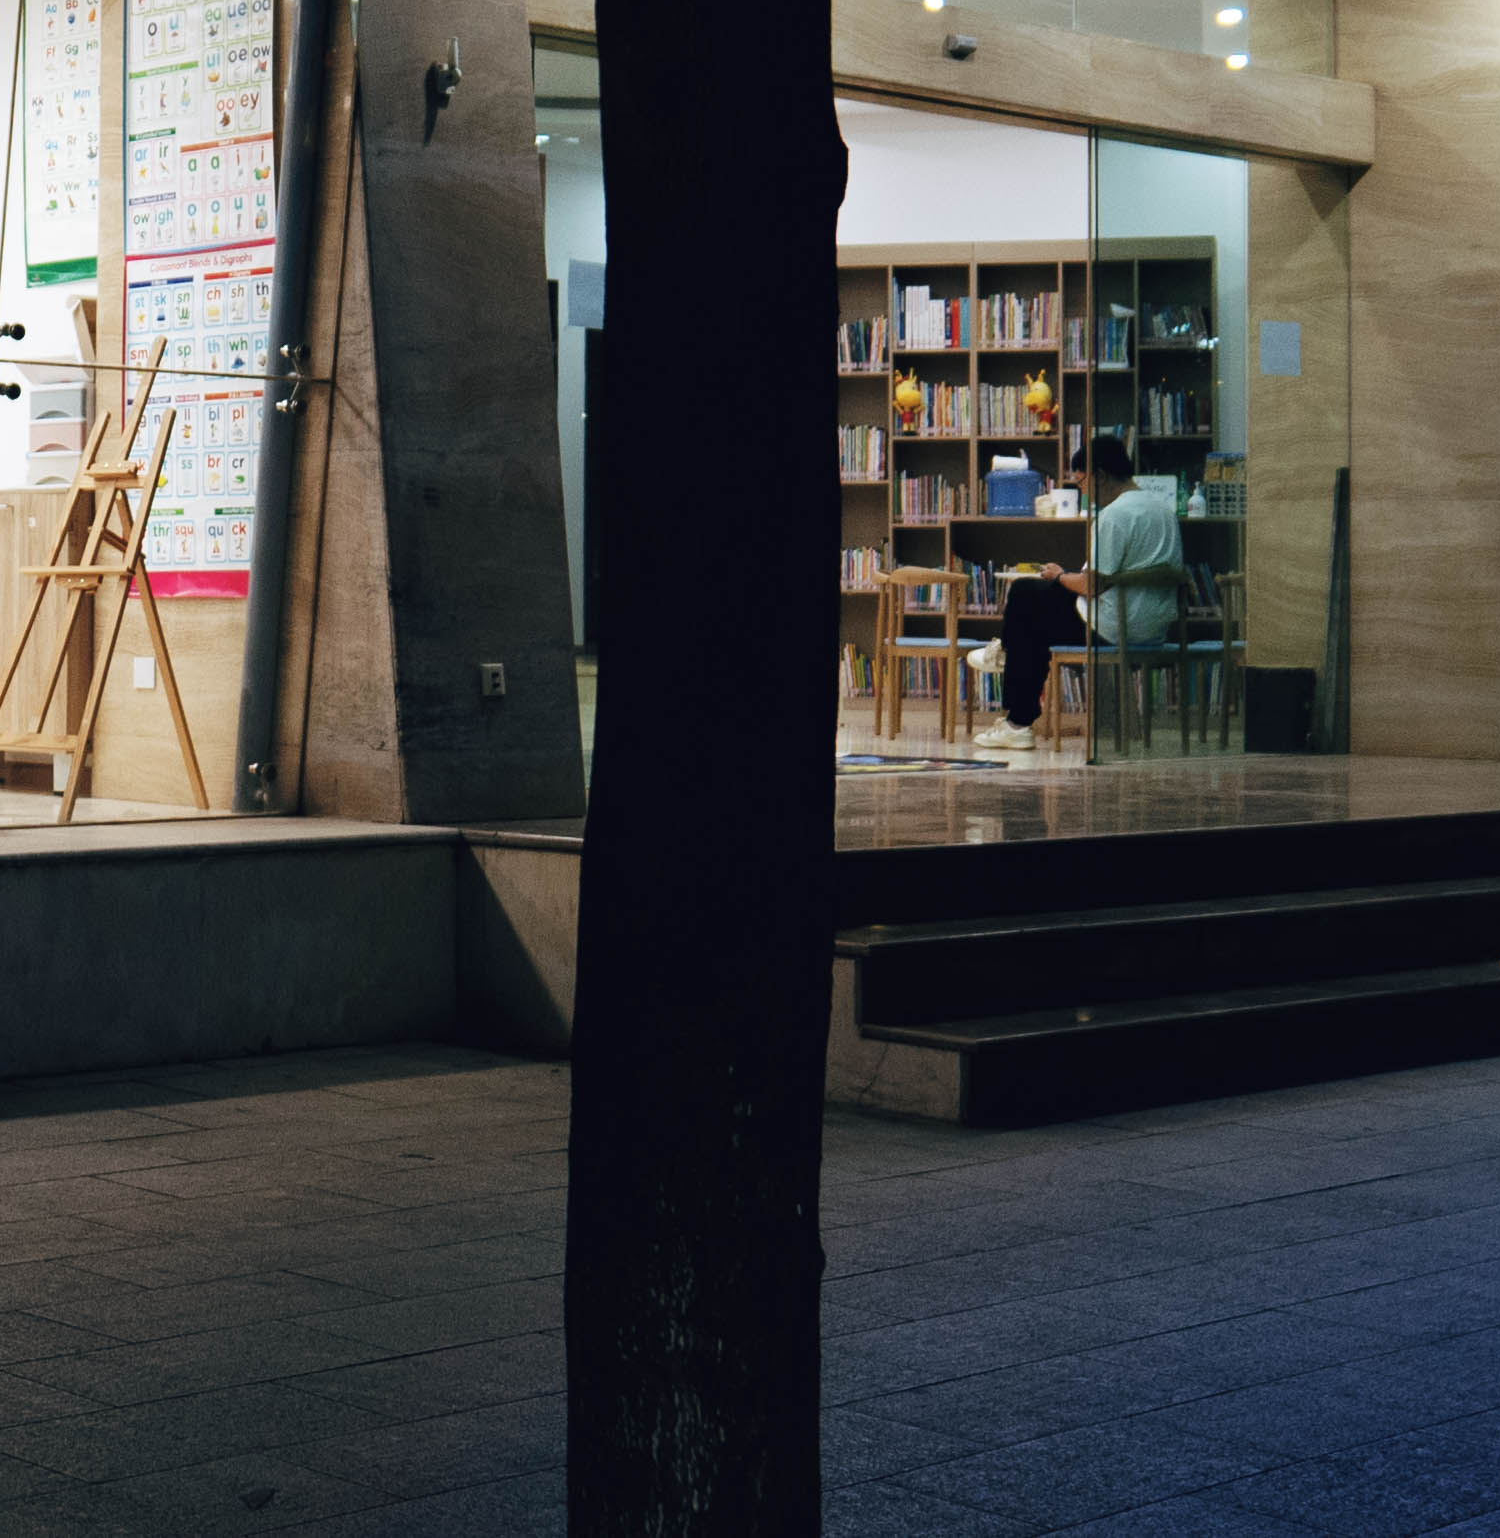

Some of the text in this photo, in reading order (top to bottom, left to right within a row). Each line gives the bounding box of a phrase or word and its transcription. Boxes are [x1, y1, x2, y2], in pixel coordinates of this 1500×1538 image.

[205, 7, 221, 21] ea
[227, 3, 247, 18] ue
[147, 23, 158, 37] o
[228, 48, 248, 63] oe
[252, 45, 271, 59] ow
[216, 92, 260, 112] oo ey
[134, 149, 148, 162] ar
[187, 158, 198, 172] a
[210, 155, 221, 170] a
[187, 193, 266, 217] o o u u
[133, 213, 150, 226] ow
[206, 281, 270, 301] ch sh th
[135, 291, 190, 309] st sk sn
[130, 349, 149, 360] sm
[177, 344, 192, 358] sp
[229, 338, 249, 351] wh
[208, 406, 221, 422] bl
[232, 405, 245, 422] pl
[207, 454, 245, 470] br cr
[153, 524, 194, 538] thr squ
[208, 521, 247, 538] qu ck
